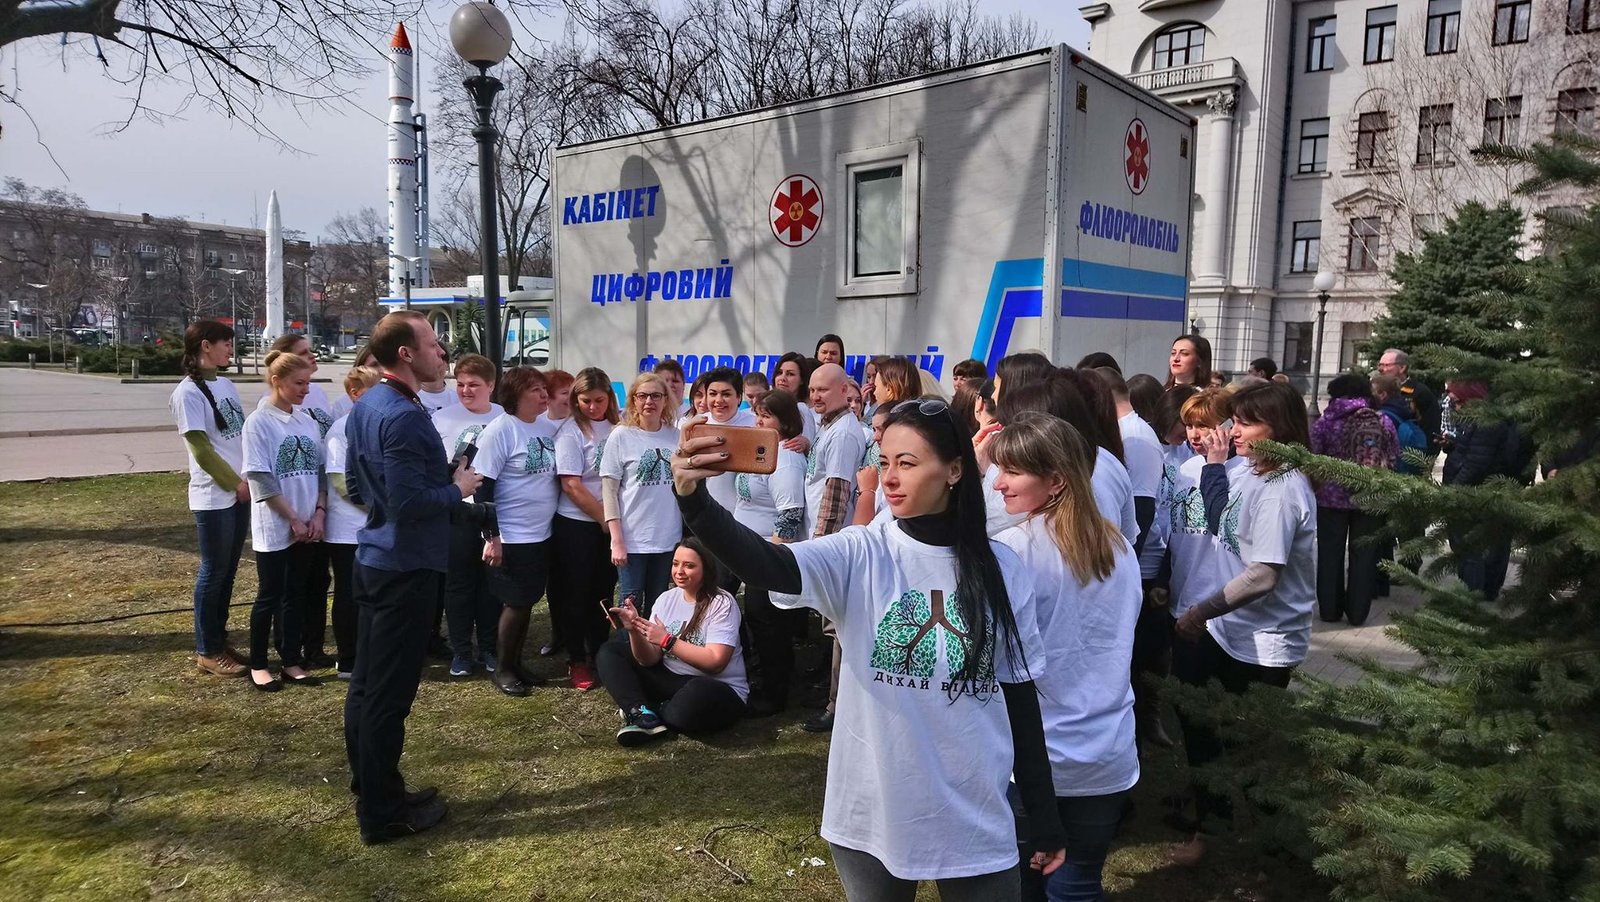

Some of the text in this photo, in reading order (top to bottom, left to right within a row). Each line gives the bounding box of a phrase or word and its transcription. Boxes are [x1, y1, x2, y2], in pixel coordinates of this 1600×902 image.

[563, 185, 660, 226] КАБІНЕТ
[1079, 200, 1179, 253] ФЛЮОРОМОБІЛЬ
[591, 258, 734, 306] ЦИФРОВИЙ
[873, 671, 930, 690] ДИХАЙ
